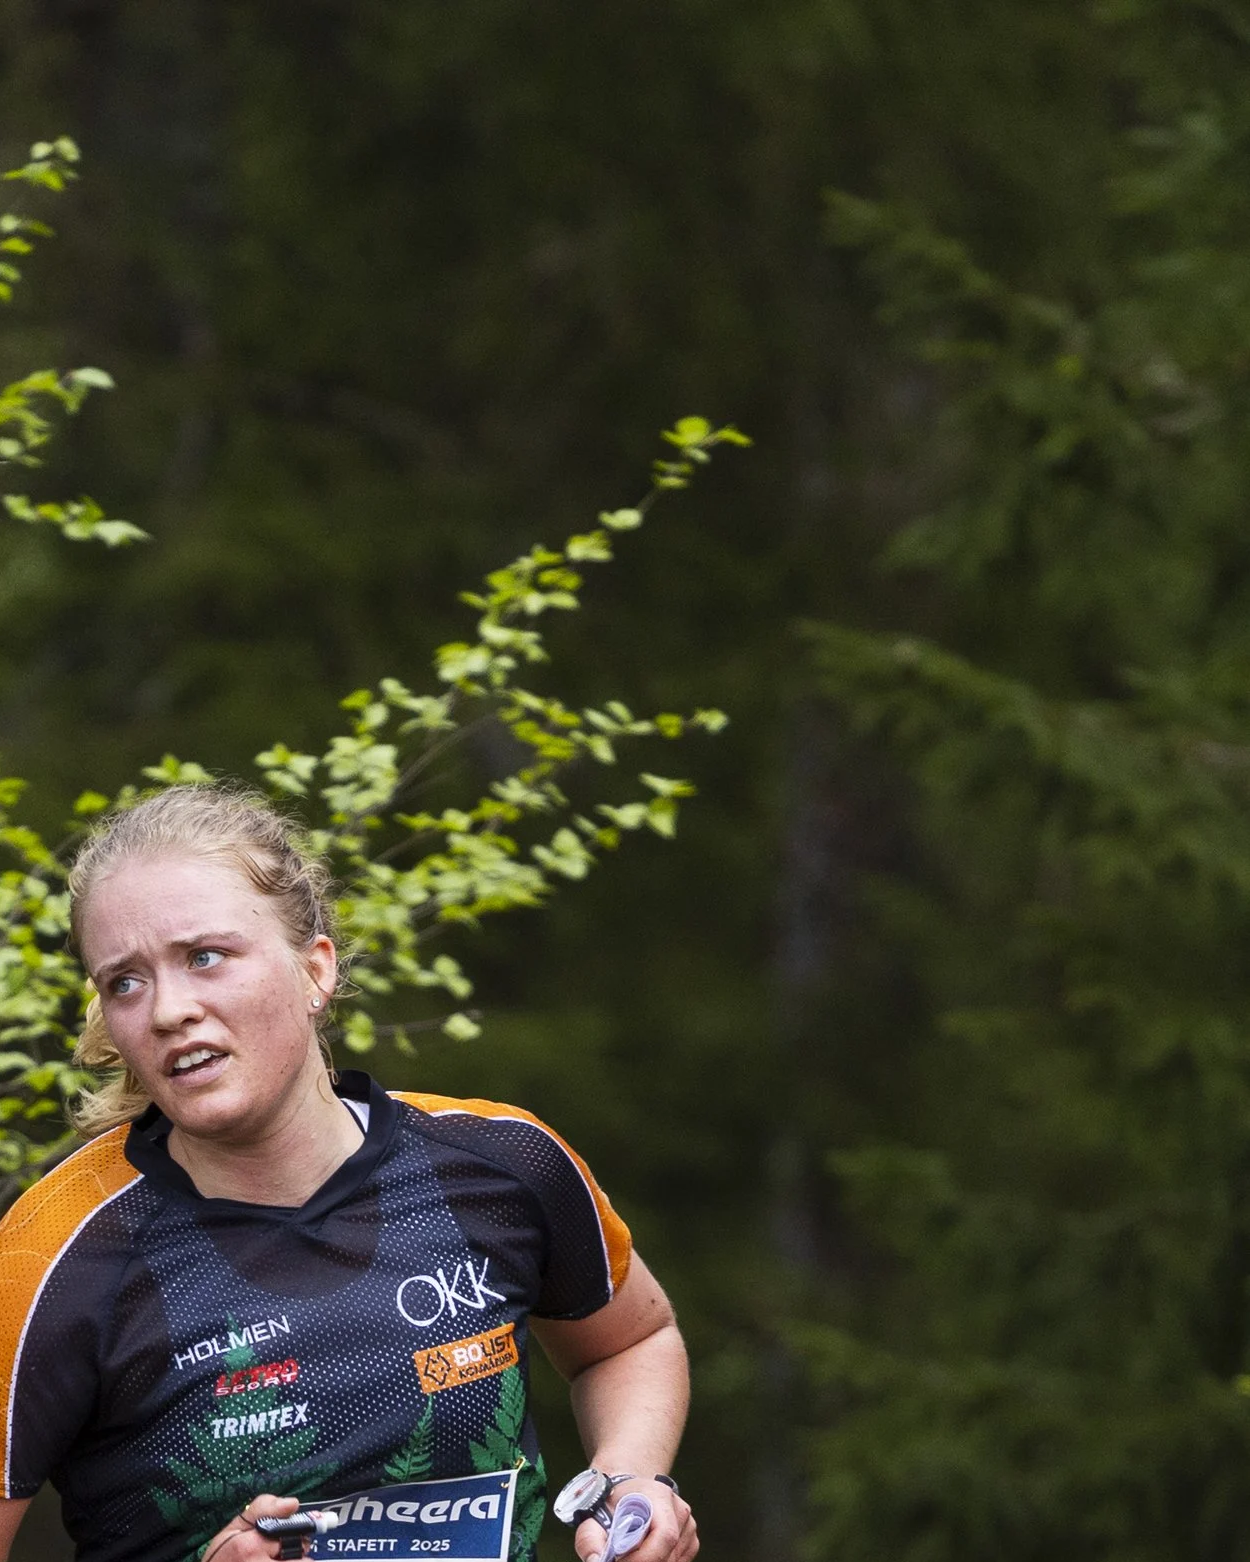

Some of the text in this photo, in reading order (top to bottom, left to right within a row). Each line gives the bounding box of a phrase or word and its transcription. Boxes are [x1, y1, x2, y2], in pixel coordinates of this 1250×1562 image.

[397, 1257, 507, 1327] OKK
[175, 1315, 291, 1370] HOLMEN
[453, 1333, 512, 1367] BOLIST
[215, 1371, 298, 1396] SPORT
[211, 1400, 309, 1439] TRIMTEX
[322, 1493, 501, 1527] gheera
[327, 1538, 398, 1552] STAFETT
[410, 1538, 451, 1552] 2025
